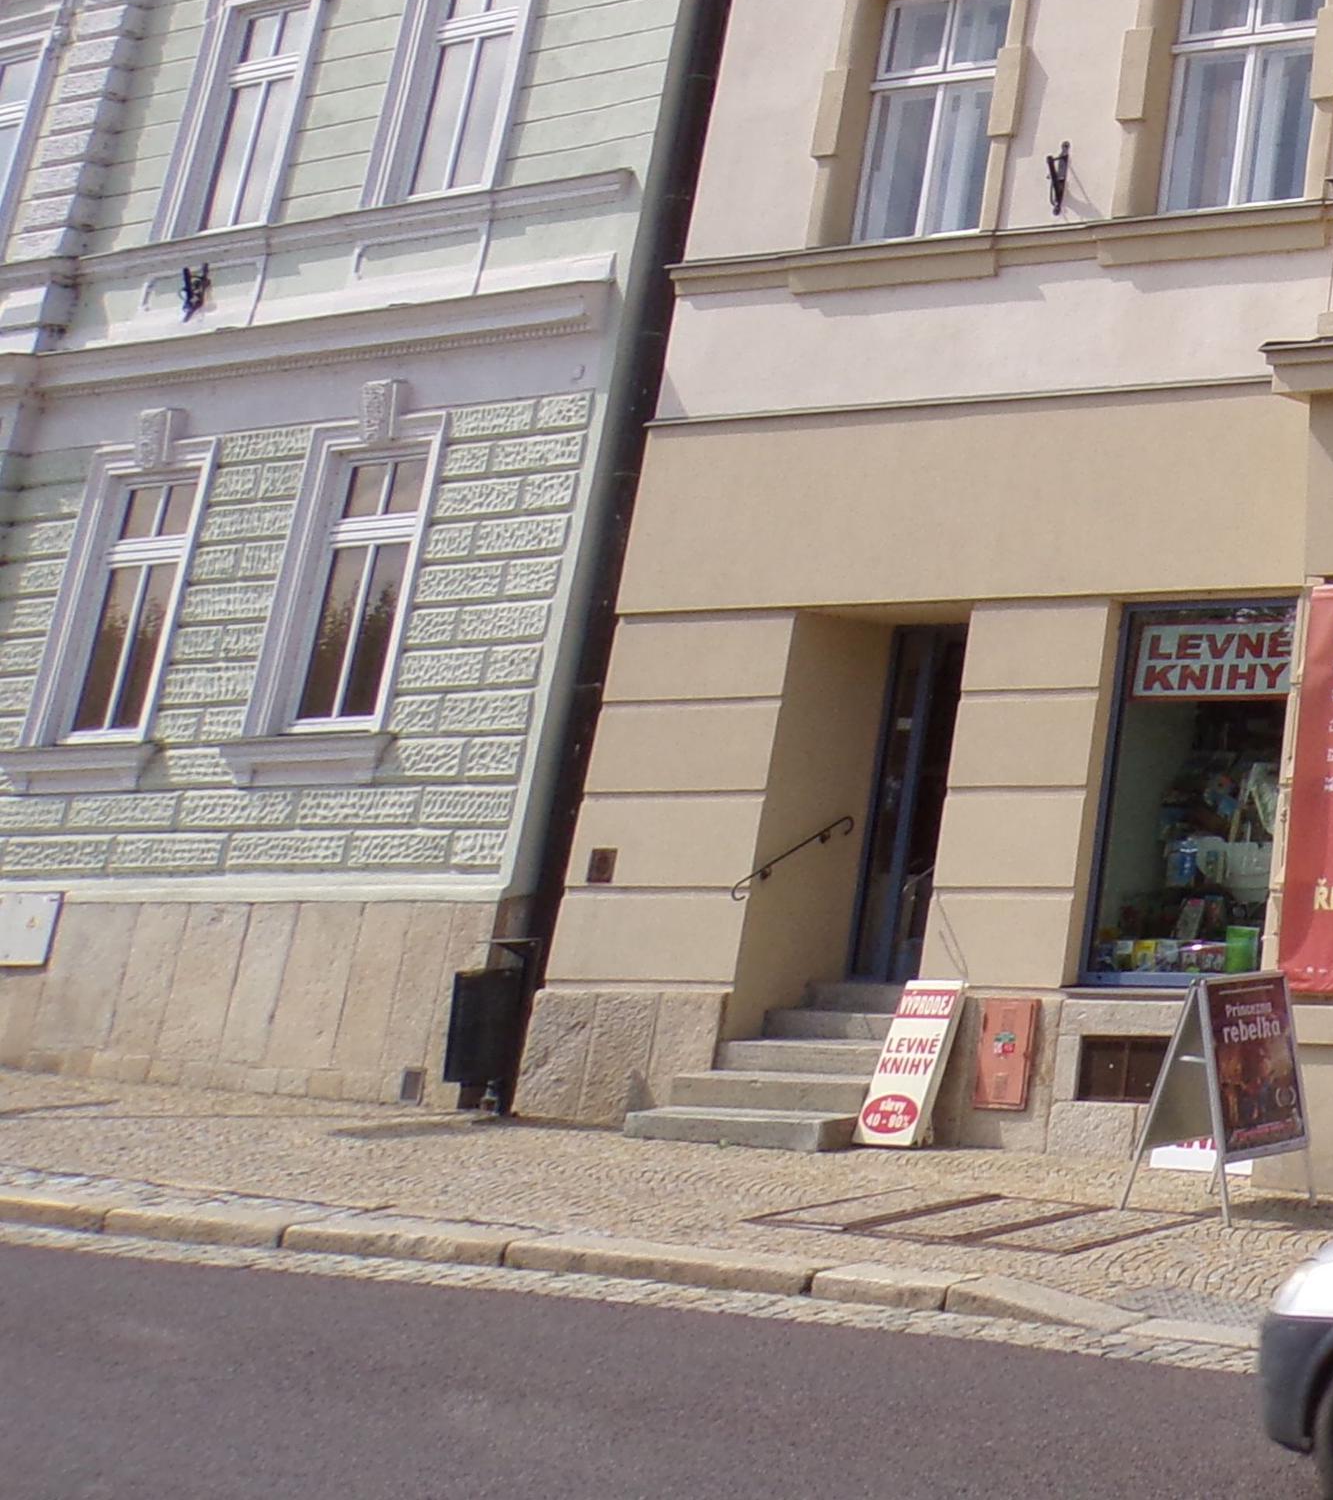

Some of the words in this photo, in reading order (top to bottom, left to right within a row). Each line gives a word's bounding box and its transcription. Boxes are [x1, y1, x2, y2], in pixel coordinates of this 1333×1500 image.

[1148, 628, 1291, 660] LEVNÉ
[1142, 662, 1290, 691] KNIHY
[901, 991, 955, 1015] VÝPRODEJ
[1222, 1016, 1281, 1044] rebelka
[886, 1034, 940, 1054] LEVNÉ
[879, 1059, 933, 1075] KNIHY
